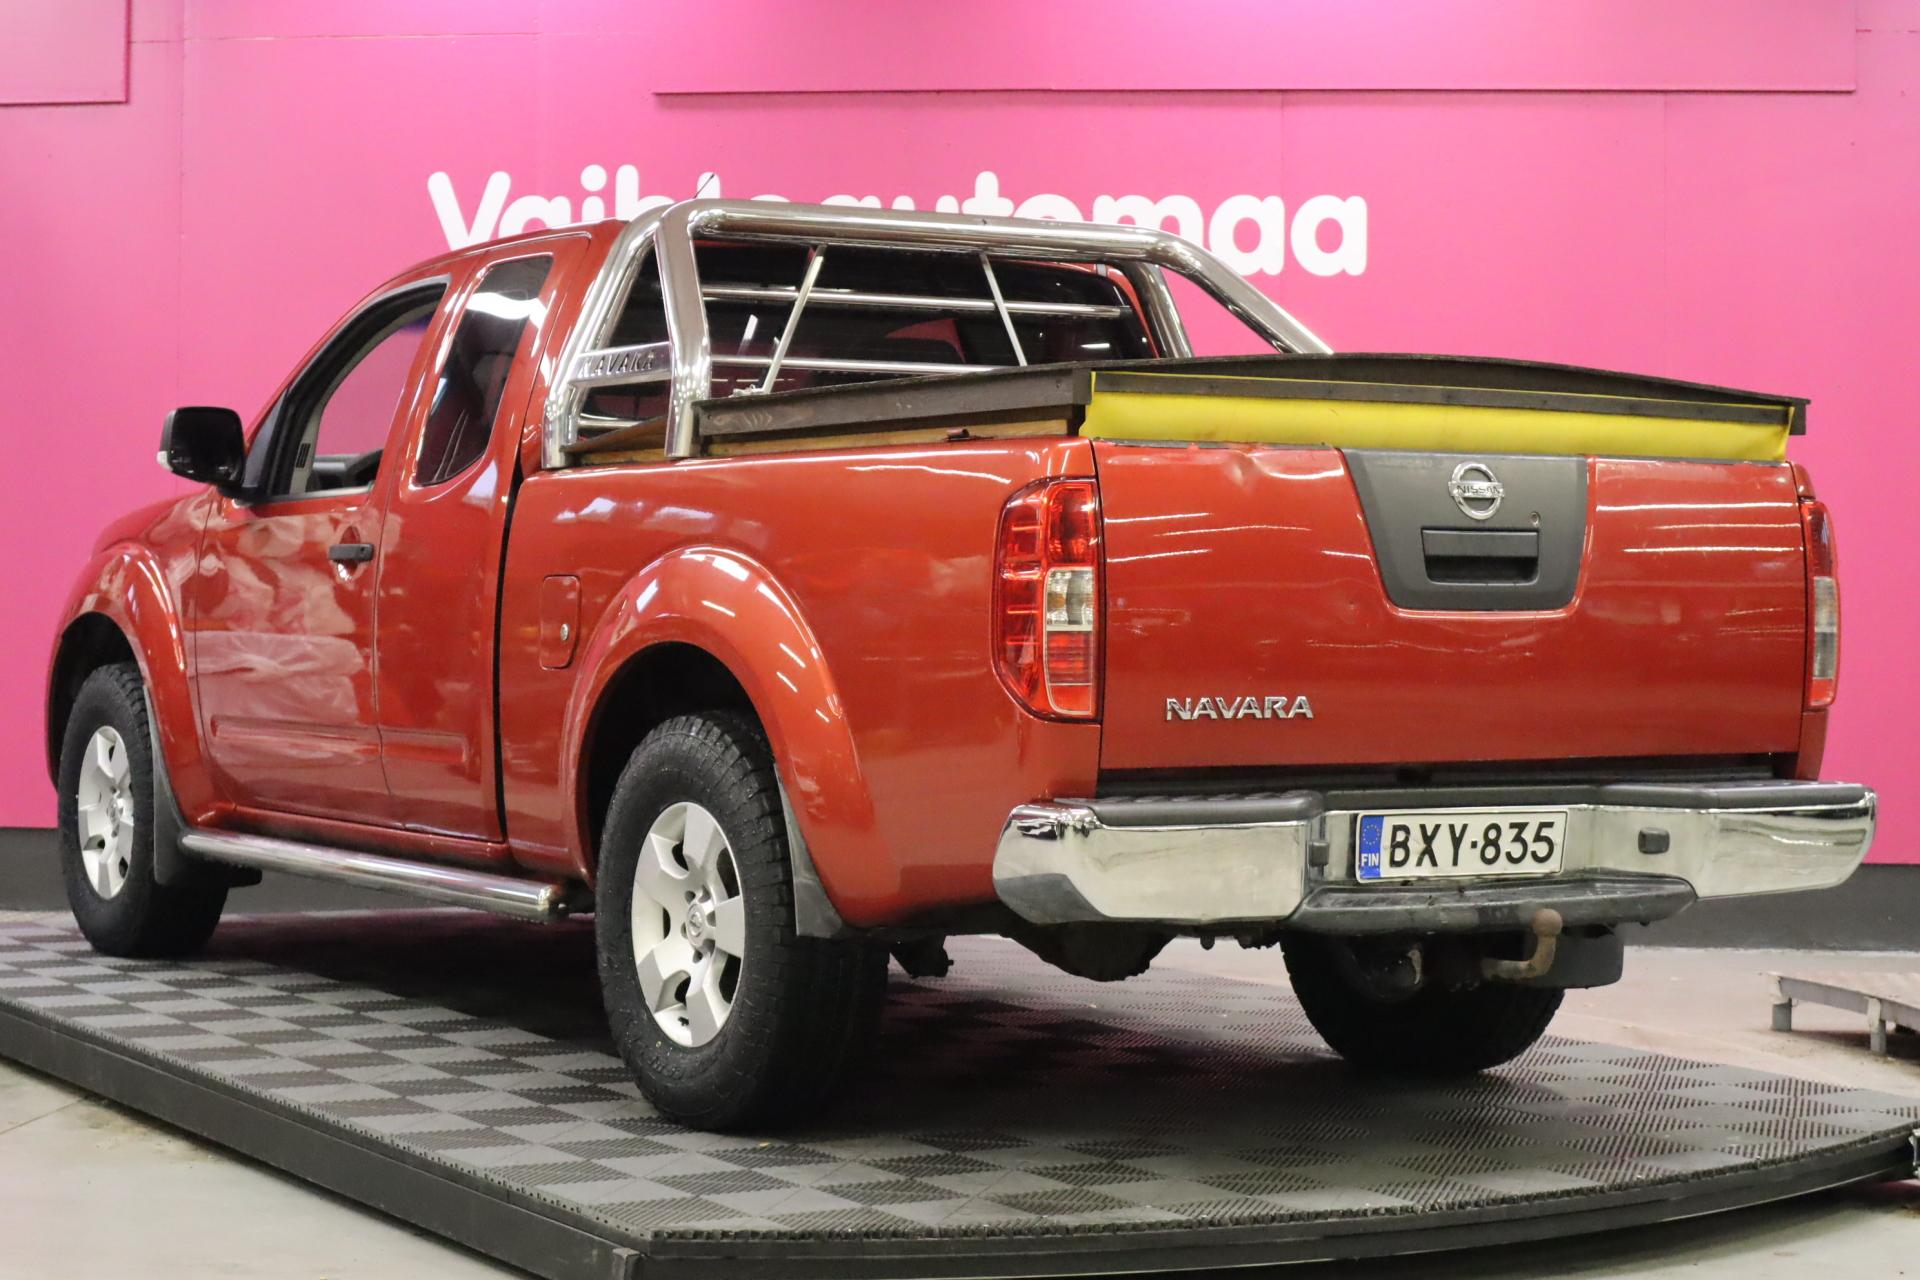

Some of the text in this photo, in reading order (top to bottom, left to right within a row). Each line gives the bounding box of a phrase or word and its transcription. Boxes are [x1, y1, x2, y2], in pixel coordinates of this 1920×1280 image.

[1456, 484, 1501, 495] NISSAN
[1166, 695, 1314, 721] NAVARA
[1361, 852, 1380, 867] FIN
